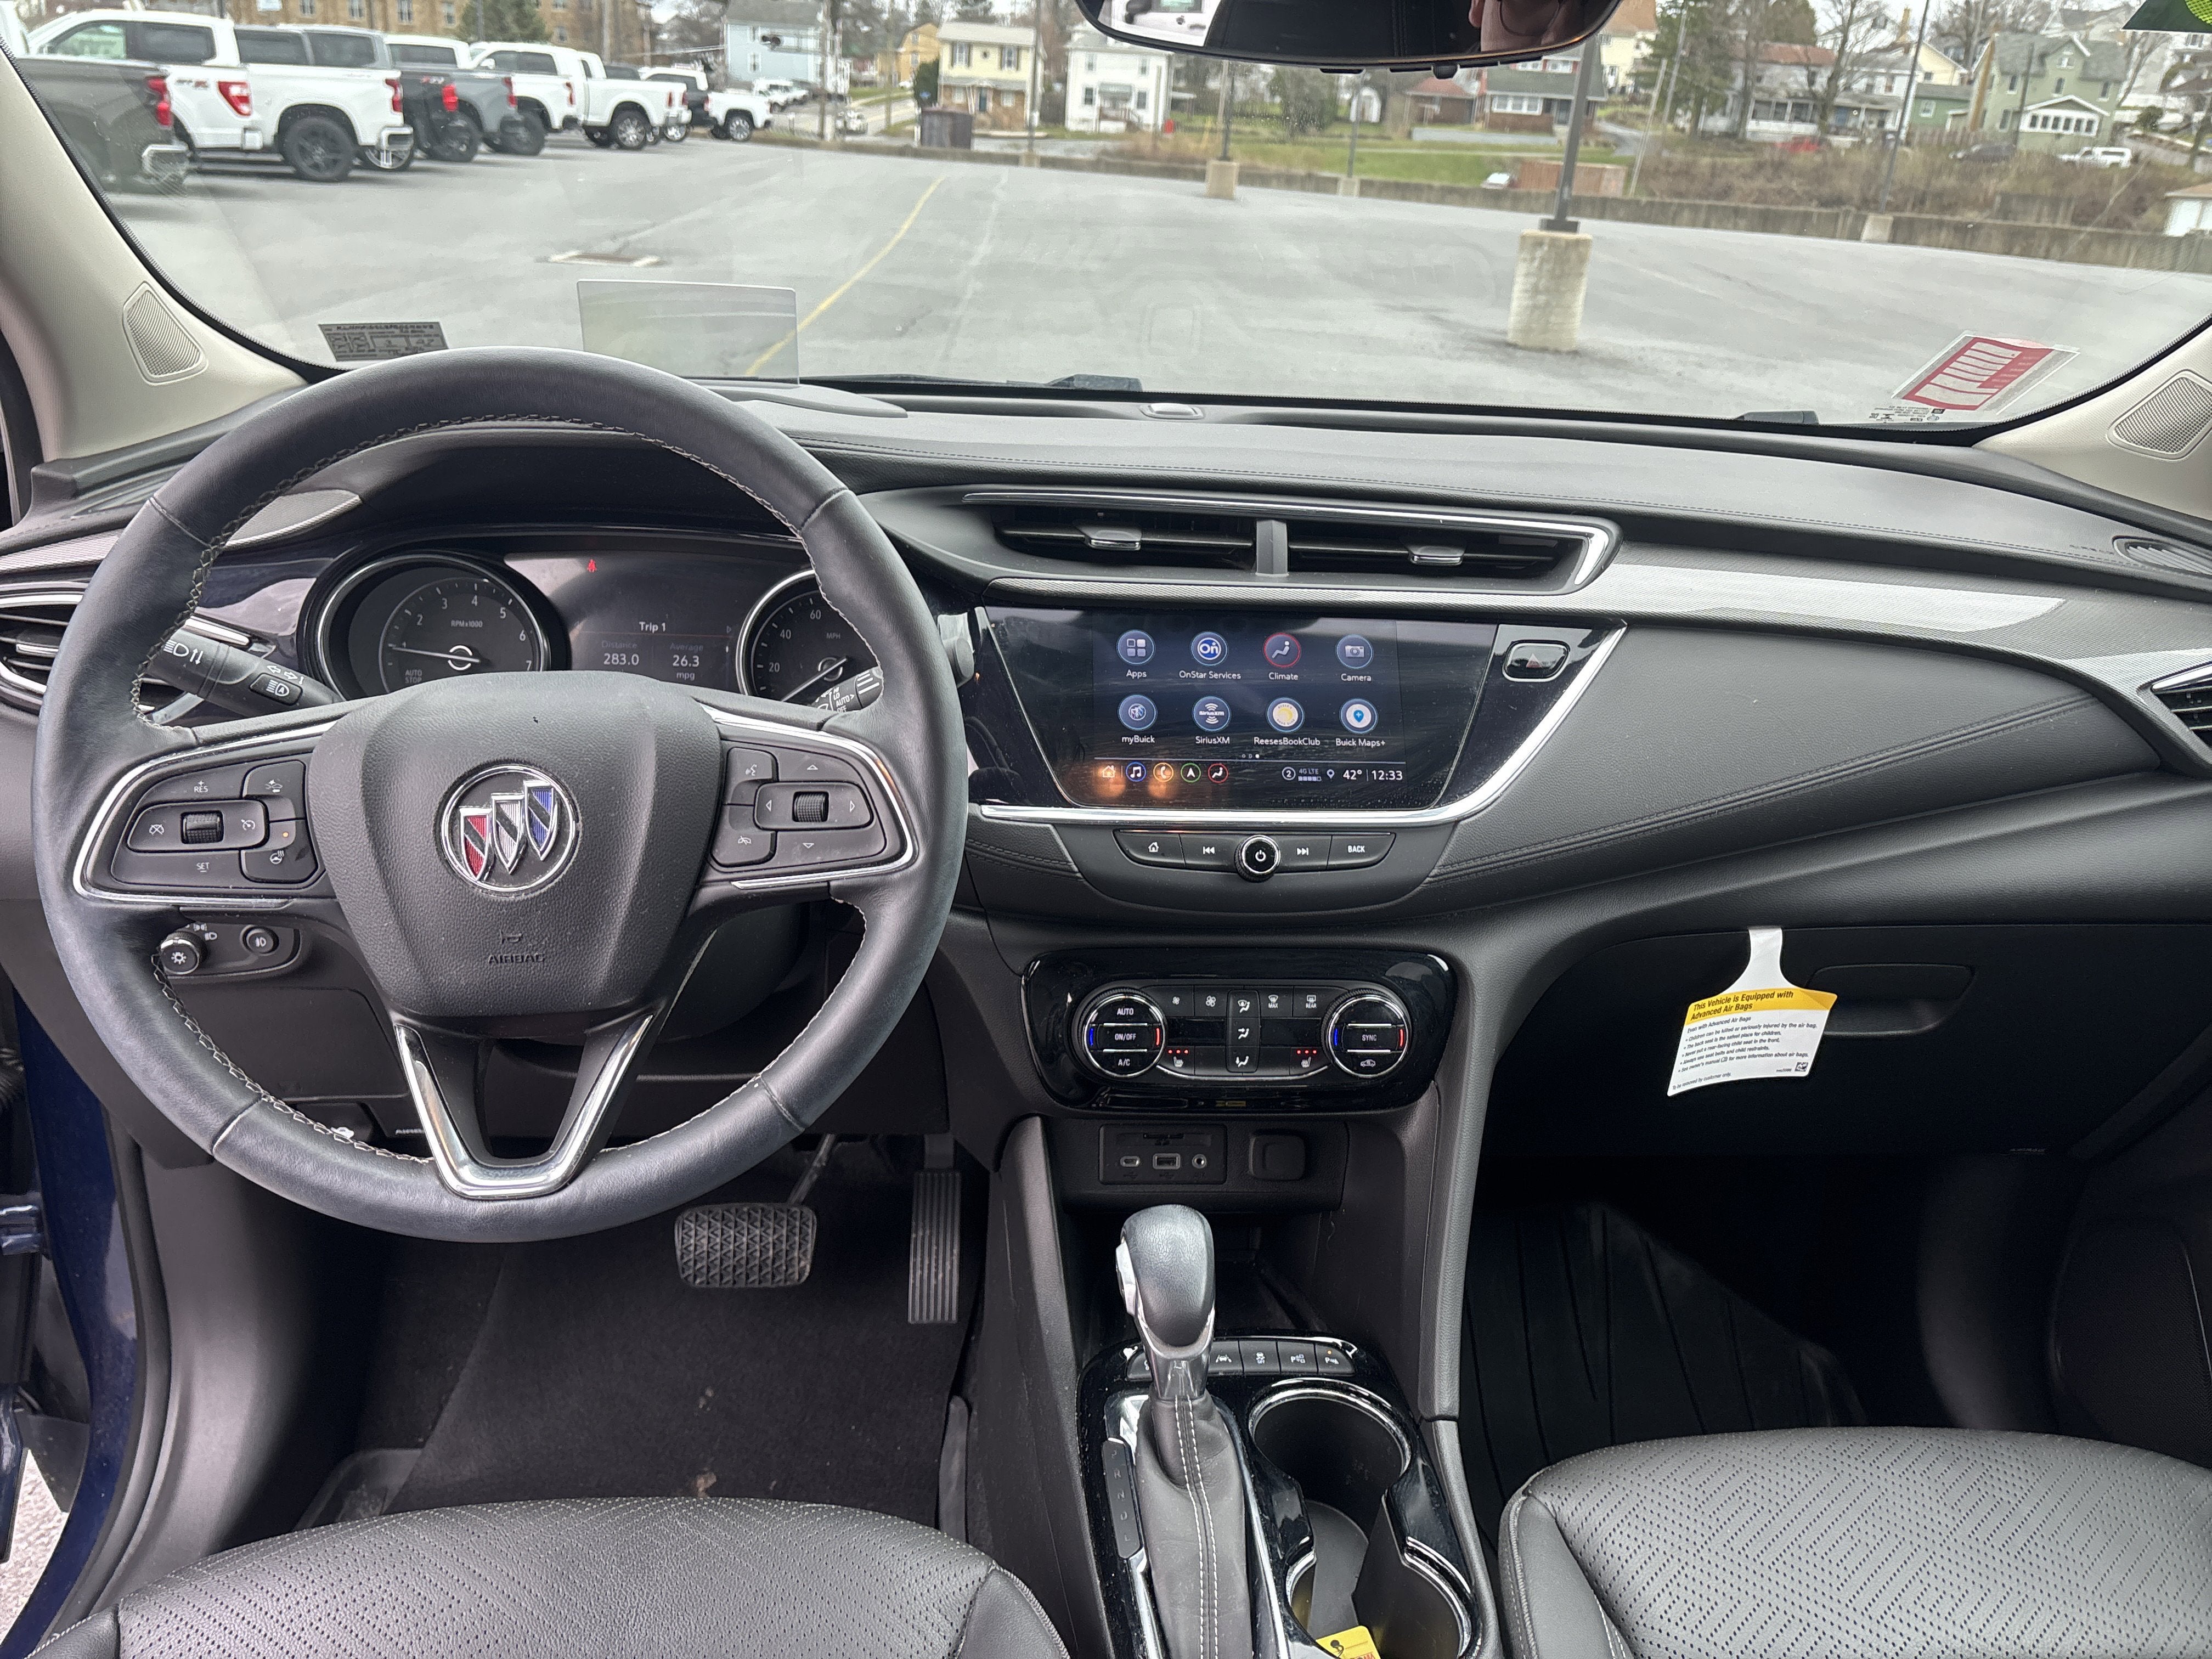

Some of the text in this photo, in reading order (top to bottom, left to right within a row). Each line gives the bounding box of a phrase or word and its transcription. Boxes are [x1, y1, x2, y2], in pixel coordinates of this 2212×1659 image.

[442, 598, 448, 610] 3
[471, 595, 478, 606] 4
[500, 607, 506, 619] 5
[810, 610, 821, 620] 60
[417, 614, 423, 625] 2
[639, 622, 666, 633] Trip 1
[520, 630, 526, 641] 6
[780, 629, 792, 639] 40
[602, 640, 637, 649] Distance
[670, 643, 703, 652] Average
[603, 653, 639, 665] 283.0
[673, 655, 699, 667] 26.3
[526, 661, 532, 671] 7
[769, 663, 780, 672] 20
[676, 672, 695, 680] mpg
[1126, 669, 1147, 679] Apps
[1179, 670, 1241, 680] OnStar Services
[1268, 672, 1299, 680] Climate
[833, 692, 840, 701] LO
[836, 695, 850, 707] AUTO
[1121, 735, 1155, 744] myBuick
[1254, 737, 1321, 746] ReesesBookClub
[1358, 739, 1386, 748] Maps+
[1343, 769, 1362, 780] 42°
[1372, 770, 1403, 780] 12:33
[1694, 1002, 1706, 1011] This
[1708, 996, 1731, 1007] Vehicle
[1741, 991, 1775, 1002] Equipped
[1690, 1007, 1722, 1021] Advanced
